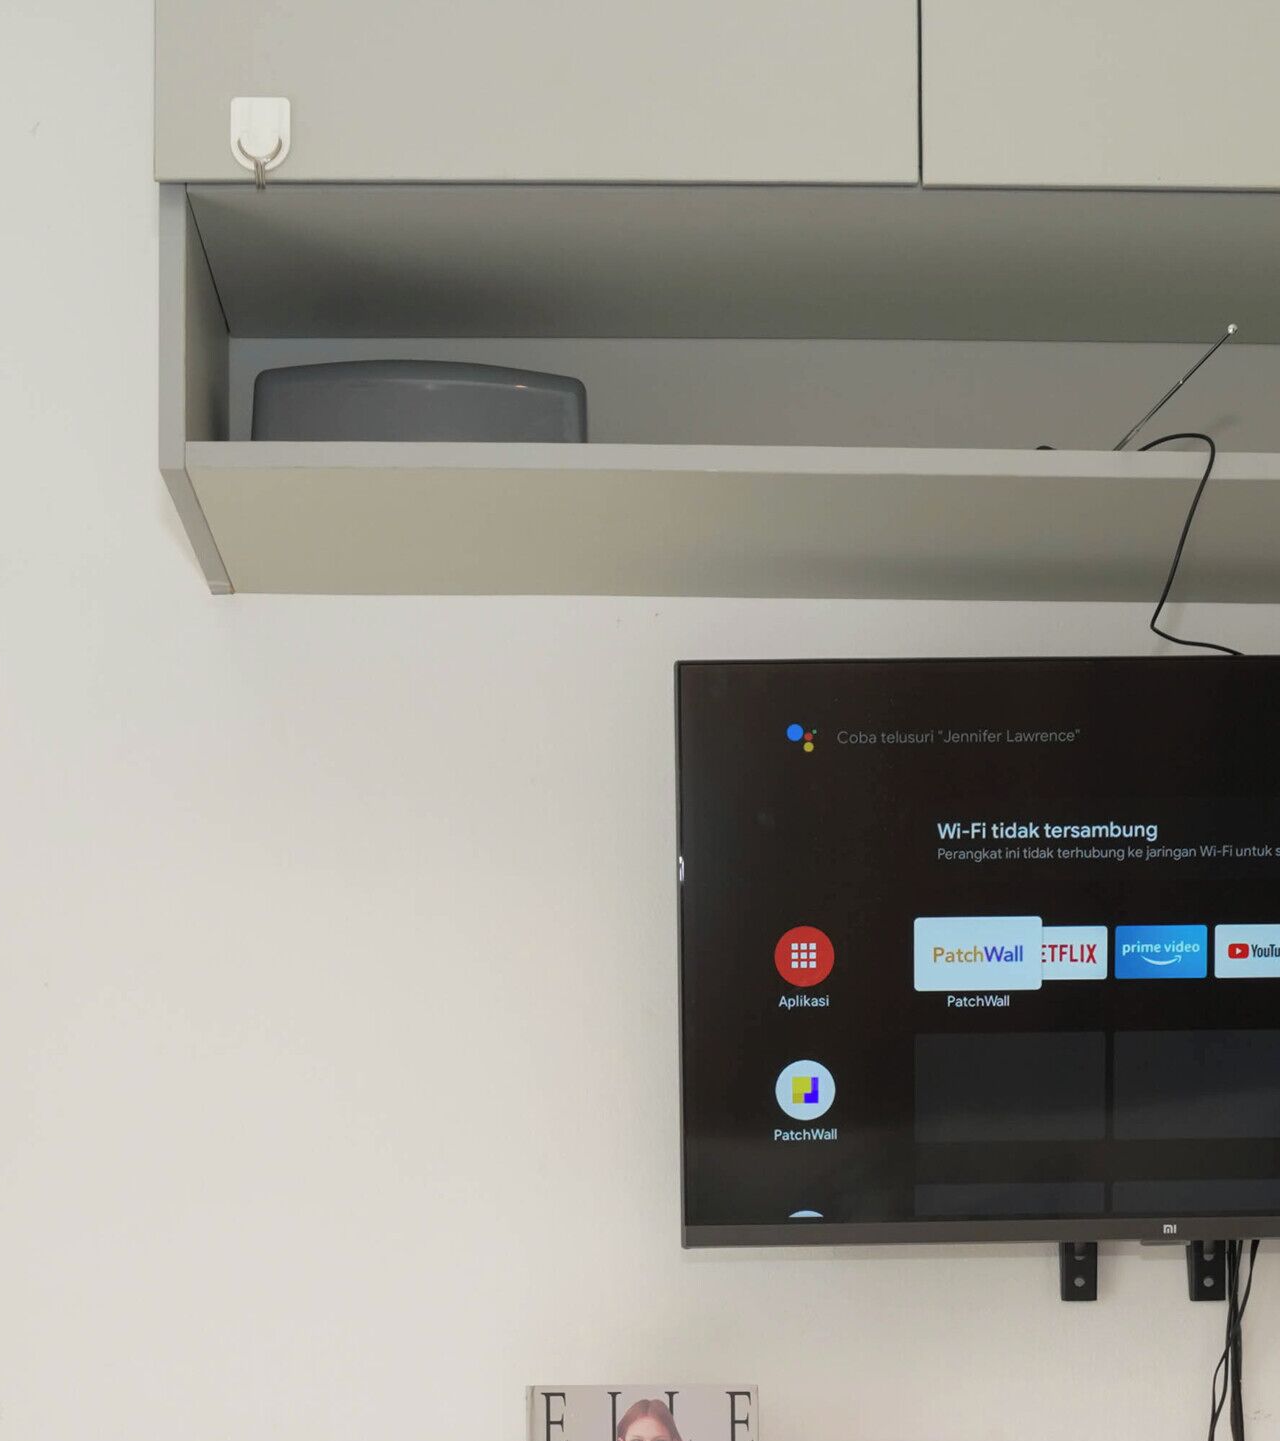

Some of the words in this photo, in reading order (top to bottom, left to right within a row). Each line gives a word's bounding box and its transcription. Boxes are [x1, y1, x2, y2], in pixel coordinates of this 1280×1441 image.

[837, 731, 877, 744] Coba
[881, 729, 934, 744] telusuri
[938, 729, 1002, 743] "Jennifer
[1006, 729, 1081, 743] Lawrence"
[937, 822, 986, 839] Wi-Fi
[991, 822, 1040, 839] tidak
[1044, 822, 1158, 841] tersambung
[937, 848, 1002, 862] Perangkat
[1005, 847, 1020, 860] ini
[1022, 846, 1054, 860] tidak
[1057, 846, 1124, 862] terhubung
[1128, 845, 1143, 858] ke
[1145, 845, 1197, 860] jaringan
[1199, 845, 1234, 858] Wi-Fi
[1236, 844, 1272, 858] untuk
[933, 945, 1024, 963] PatchWall
[1122, 942, 1161, 956] prime
[1164, 941, 1200, 954] video
[778, 995, 830, 1010] Aplikasi
[947, 995, 1010, 1007] PatchWall
[774, 1129, 838, 1141] PatchWall
